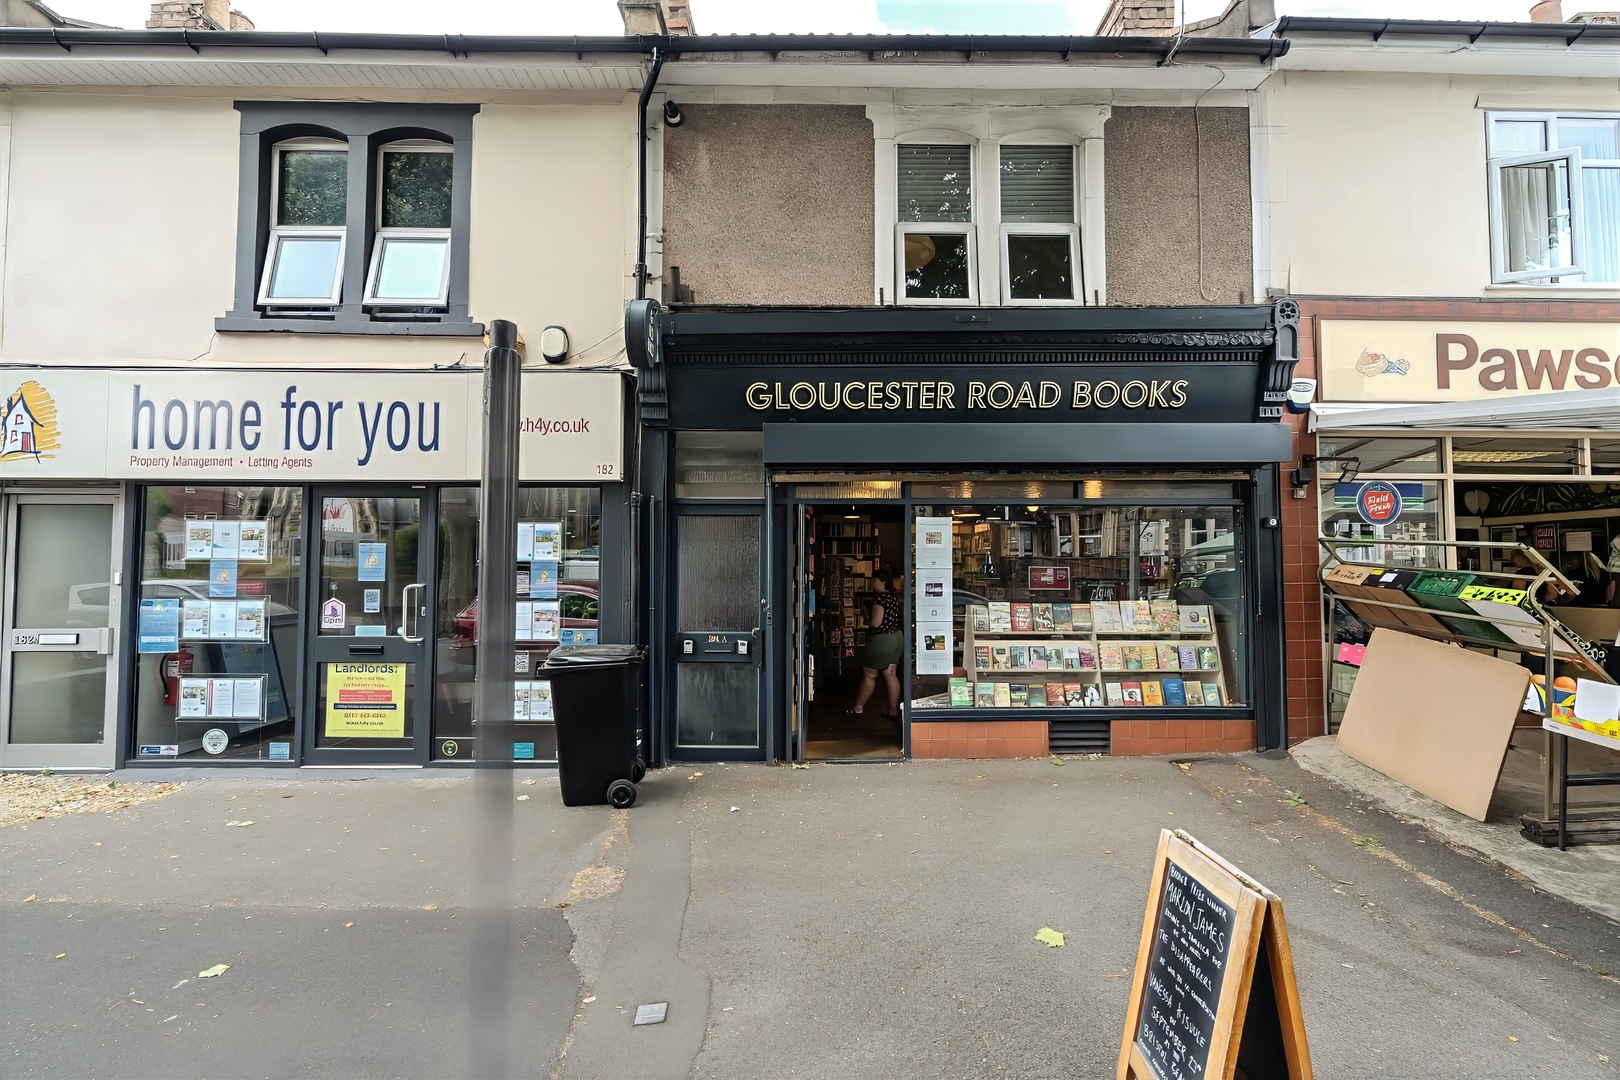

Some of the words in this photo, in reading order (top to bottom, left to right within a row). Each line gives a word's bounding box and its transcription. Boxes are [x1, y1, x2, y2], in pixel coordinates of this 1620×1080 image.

[1436, 333, 1620, 391] Paws
[745, 381, 956, 410] GLOUCESTER
[966, 381, 1062, 409] ROAD
[1072, 380, 1189, 409] BOOKS
[131, 384, 262, 450] home
[281, 386, 343, 450] for
[357, 400, 440, 467] you
[130, 455, 170, 468] Property
[172, 456, 233, 468] Management
[248, 456, 279, 469] Letting
[281, 457, 313, 469] Agents
[597, 464, 614, 475] 182
[335, 663, 398, 673] Landlords:
[1165, 878, 1196, 923] MARLON
[1192, 908, 1225, 953] JAMES
